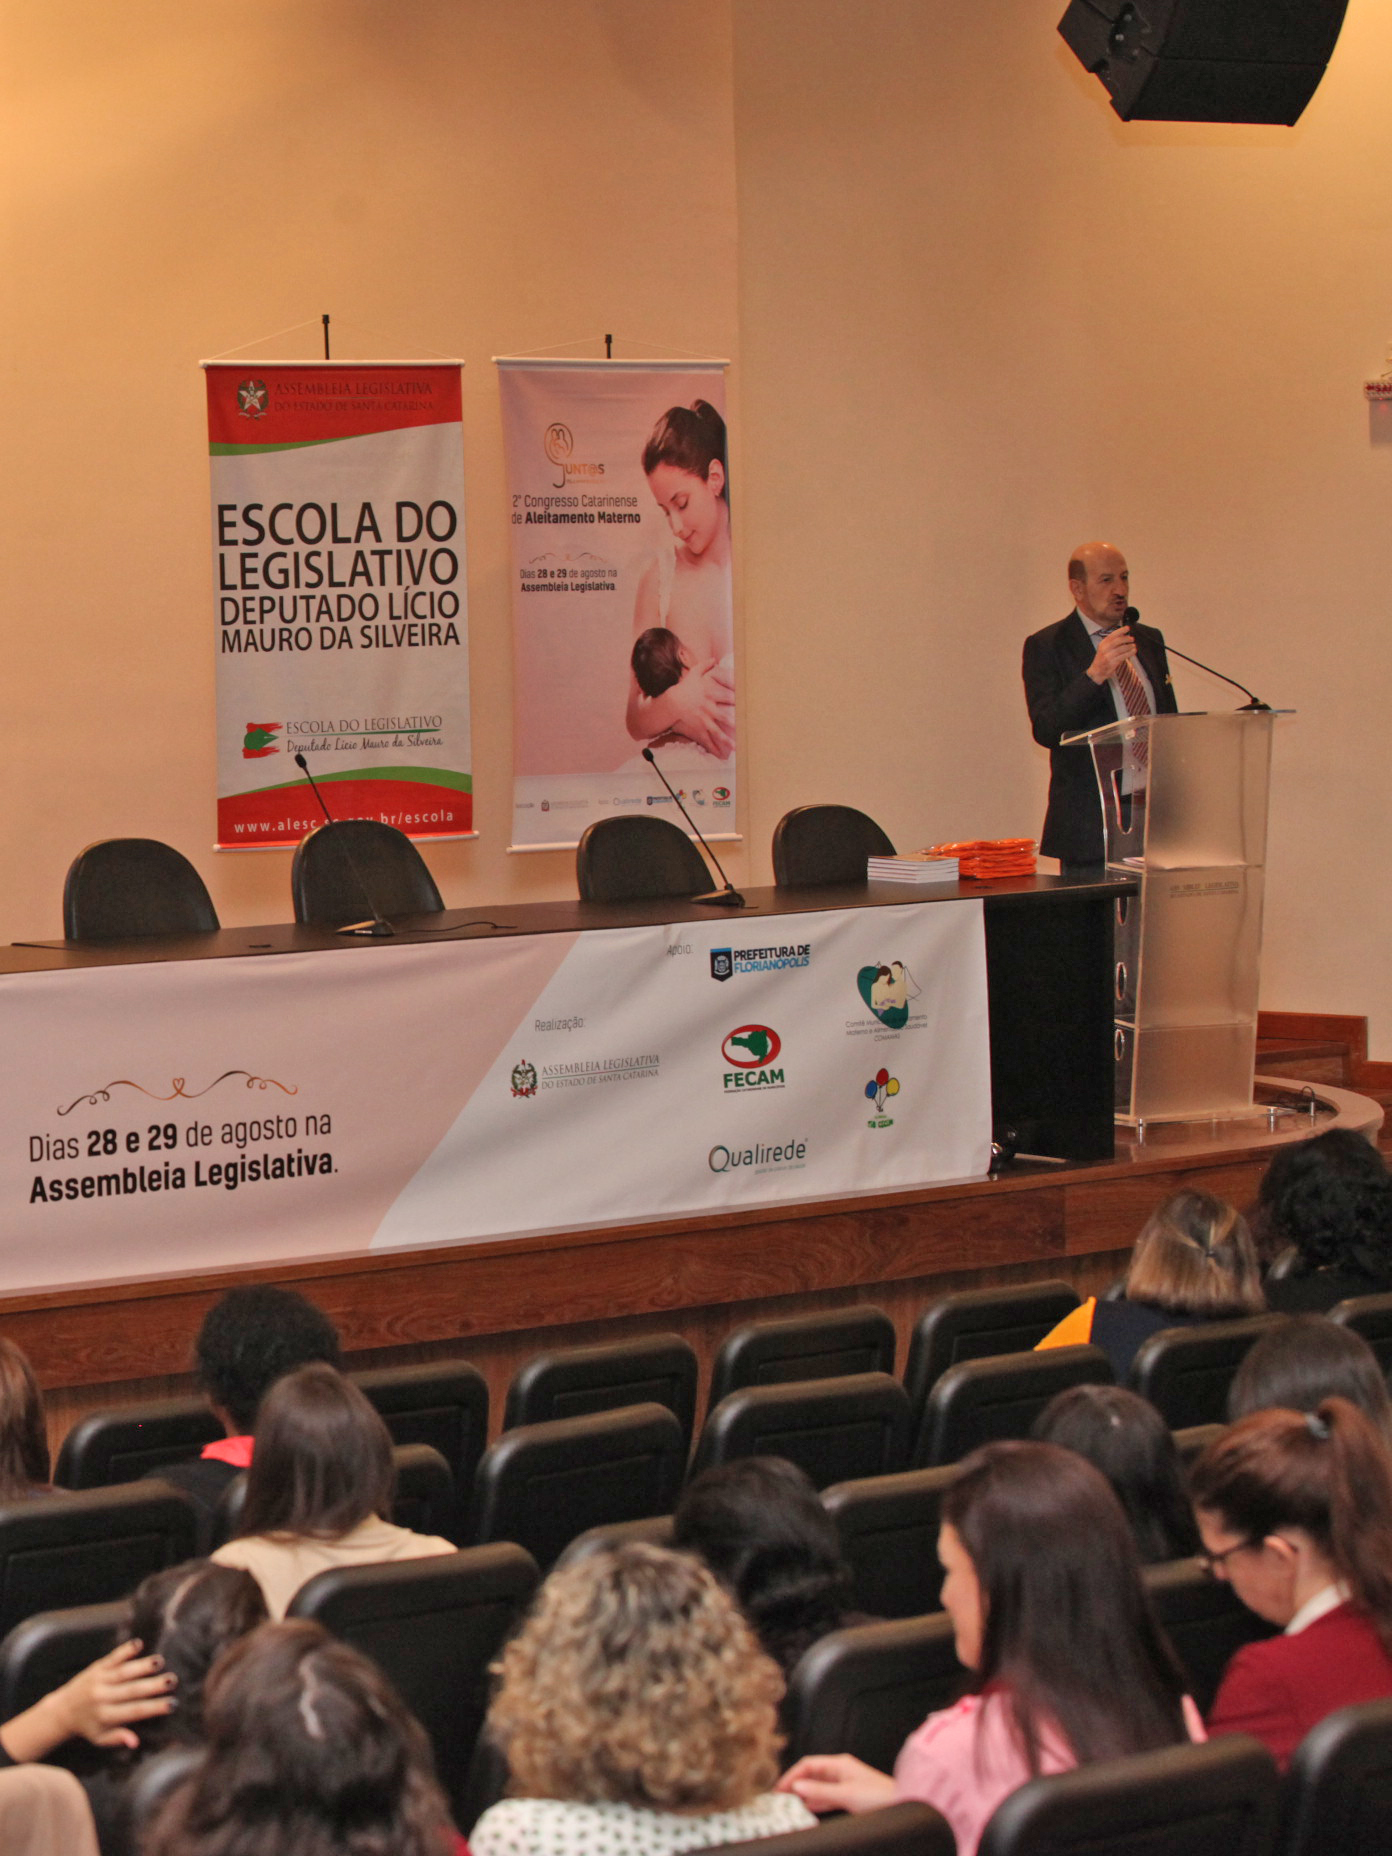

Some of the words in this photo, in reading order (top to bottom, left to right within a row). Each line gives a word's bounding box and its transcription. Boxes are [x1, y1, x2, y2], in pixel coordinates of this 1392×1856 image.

[274, 383, 351, 395] ASSEMBLEIA
[355, 382, 433, 394] LEGISLATIVA
[524, 494, 579, 510] Congresso
[581, 494, 638, 507] Catarinense
[217, 502, 382, 547] ESCOLA
[396, 500, 457, 543] DO
[511, 513, 523, 524] de
[525, 510, 595, 524] Aleitamento
[597, 511, 641, 524] Materno
[219, 547, 459, 591] LEGISLATIVO
[519, 569, 536, 579] Dias
[537, 569, 548, 578] 28
[550, 570, 555, 578] e
[557, 569, 567, 578] 29
[569, 569, 578, 578] de
[580, 569, 606, 580] agosto
[608, 569, 618, 578] na
[521, 581, 569, 592] Assembleia
[220, 593, 380, 626] DEPUTADO
[388, 585, 460, 621] LÍCIO
[221, 626, 313, 654] MAURO
[319, 626, 354, 651] DA
[360, 622, 461, 649] SILVEIRA
[286, 721, 335, 735] ESCOLA
[339, 719, 359, 732] DO
[364, 715, 443, 731] LEGISLATIVO
[287, 737, 332, 753] Deputado
[360, 737, 389, 750] Mauro
[392, 735, 404, 748] da
[407, 732, 443, 747] Silveira
[734, 946, 795, 961] PREFEITURA
[797, 944, 811, 956] DE
[542, 1061, 600, 1077] ASSEMBLEIA
[603, 1054, 660, 1070] LEGISLATIVA
[541, 1079, 554, 1090] DO
[556, 1076, 585, 1088] ESTADO
[587, 1076, 598, 1084] DE
[599, 1073, 621, 1083] SANTA
[622, 1069, 659, 1080] CATARINA
[723, 1069, 785, 1088] FECAM
[29, 1133, 79, 1162] Dias
[87, 1128, 117, 1157] 28
[126, 1131, 140, 1152] e
[147, 1123, 178, 1151] 29
[185, 1121, 213, 1147] de
[221, 1115, 297, 1149] agosto
[305, 1113, 332, 1136] na
[29, 1162, 186, 1204] Assembleia
[194, 1148, 338, 1191] Legislativa.
